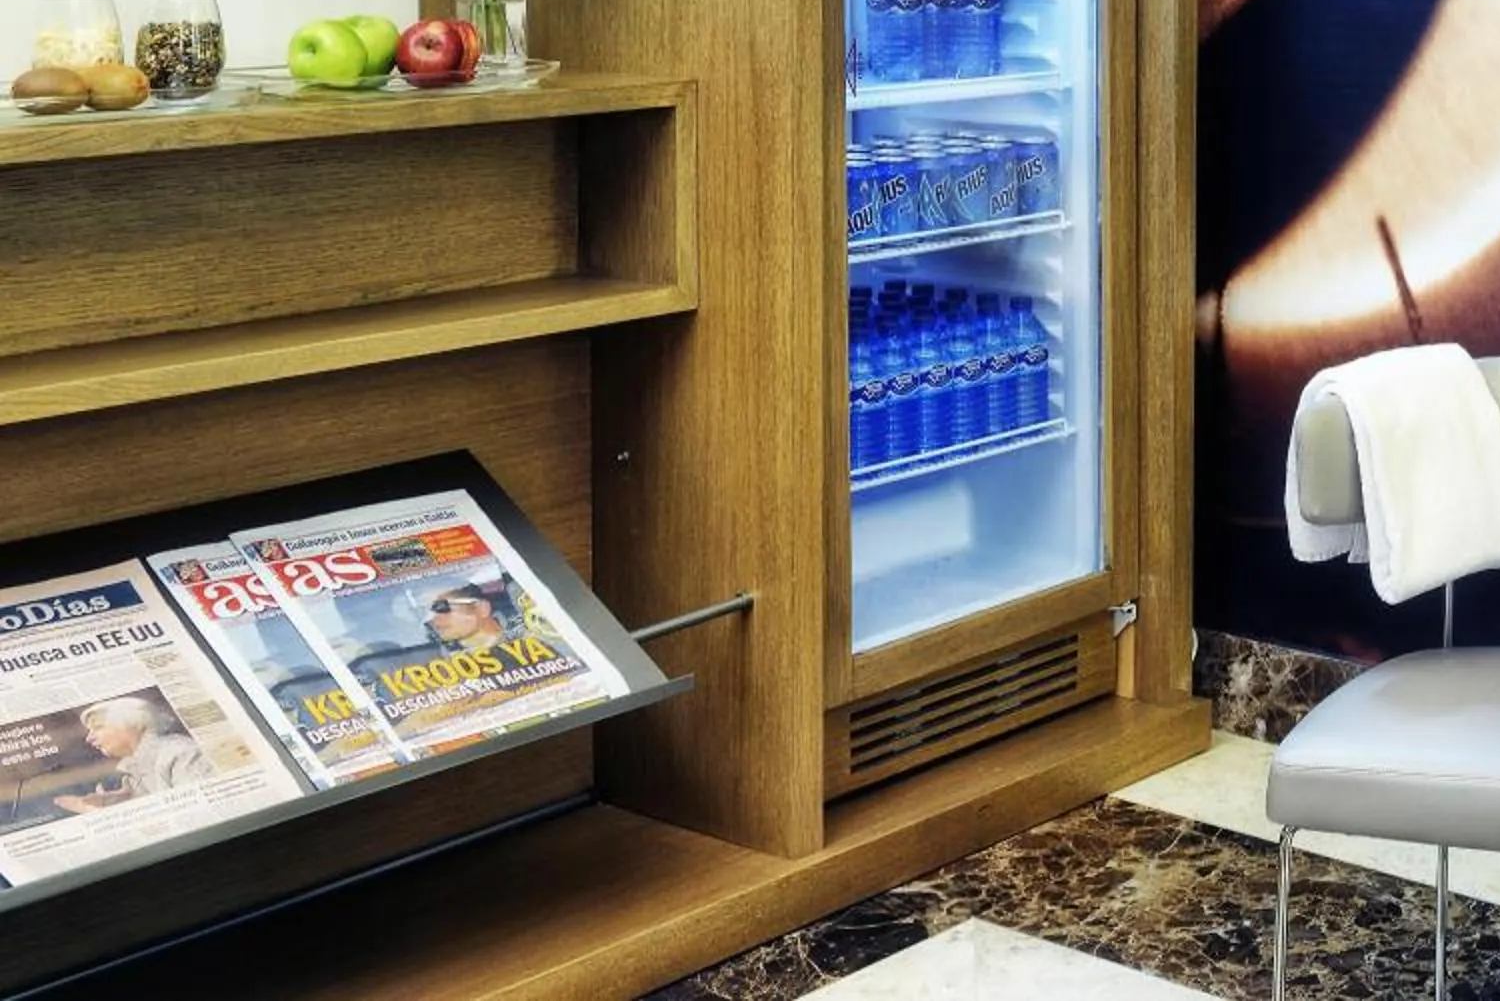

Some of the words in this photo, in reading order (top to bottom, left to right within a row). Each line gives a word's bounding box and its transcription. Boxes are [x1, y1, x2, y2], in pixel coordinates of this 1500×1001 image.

[283, 550, 377, 596] as
[0, 647, 68, 673] busca
[69, 639, 98, 657] en
[96, 627, 130, 650] EE
[128, 620, 165, 643] UU
[381, 649, 504, 698] KROOS
[498, 636, 557, 666] YA
[384, 680, 474, 719] DESCANSA
[496, 656, 583, 689] MALLORCA
